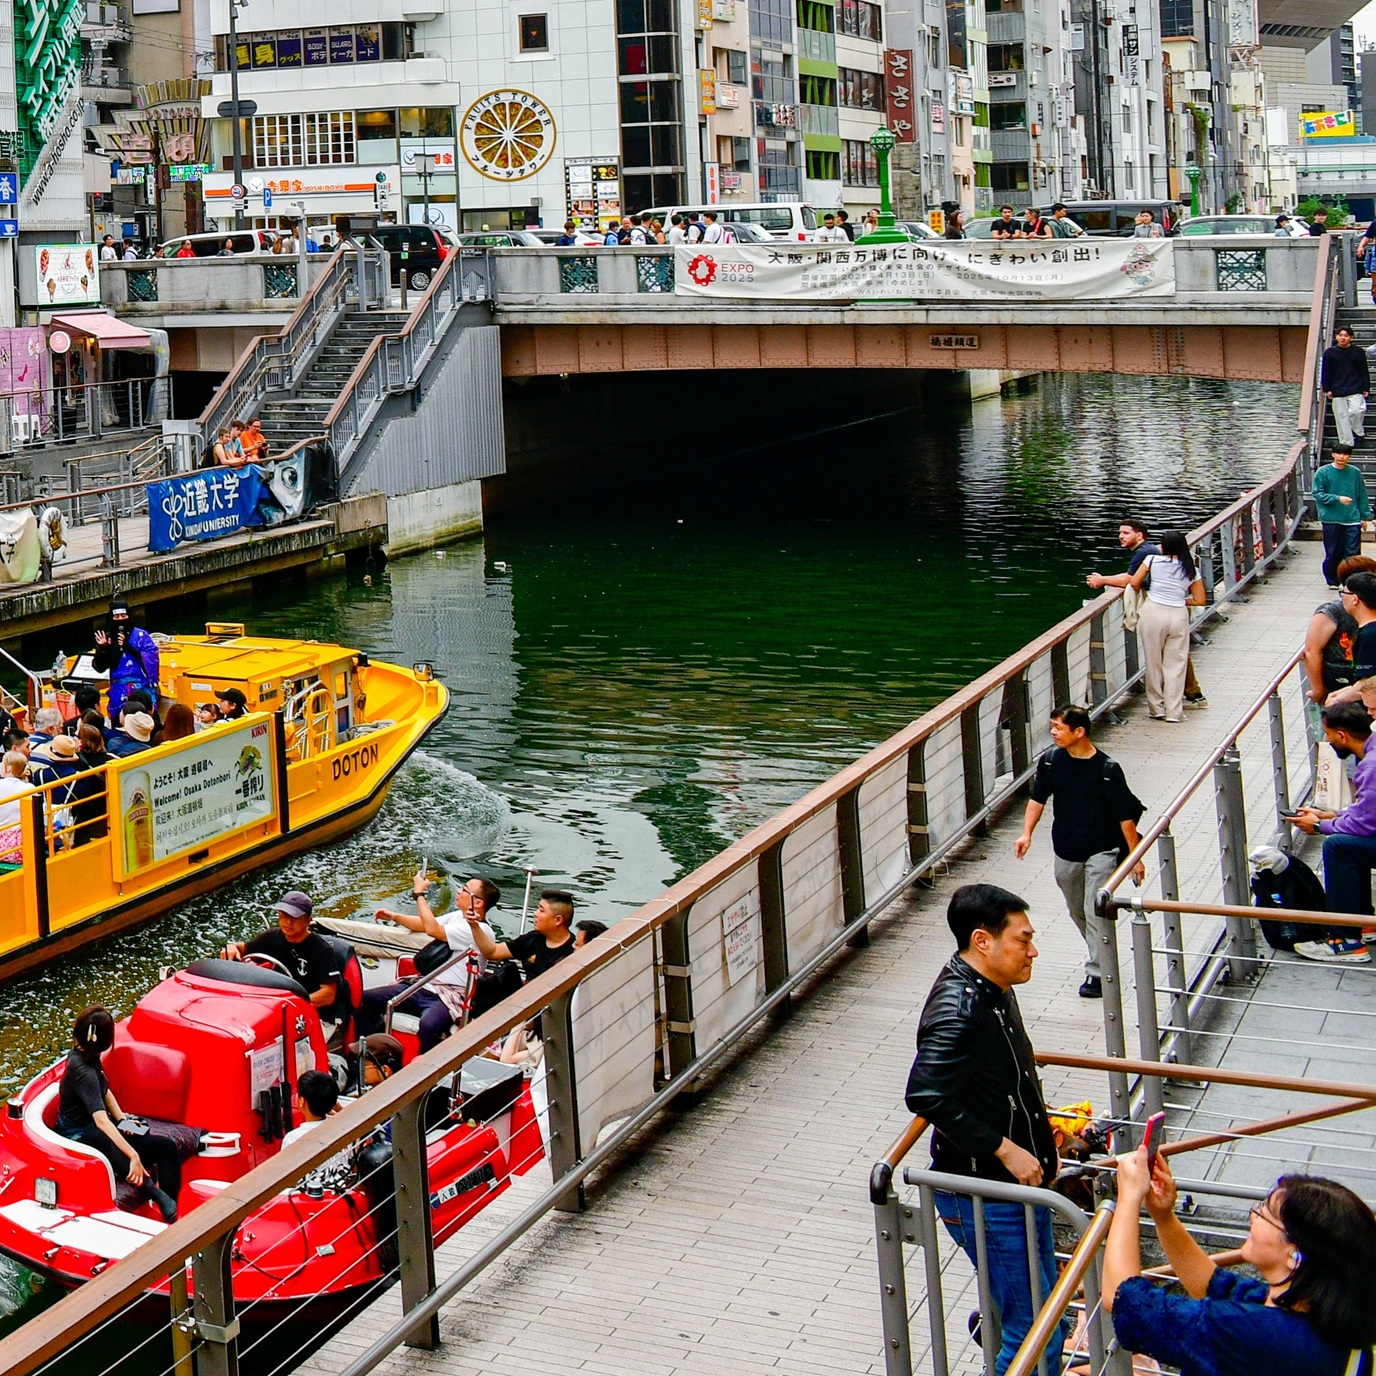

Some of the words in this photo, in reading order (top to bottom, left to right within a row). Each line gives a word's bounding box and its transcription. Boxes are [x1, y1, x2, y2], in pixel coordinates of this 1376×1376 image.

[888, 54, 912, 138] ささや
[464, 93, 501, 131] FRUITS
[512, 92, 551, 126] TOWER
[471, 154, 545, 178] フルーツタワー
[721, 263, 754, 273] EXPO
[721, 273, 754, 282] 2025
[181, 473, 240, 518] 近畿大学
[251, 723, 268, 738] KIRIN
[332, 742, 379, 782] DOTON
[154, 789, 182, 808] Welcome!
[184, 784, 202, 797] Osaka
[203, 771, 231, 790] Dotonbori
[235, 774, 265, 798] 一番搾り
